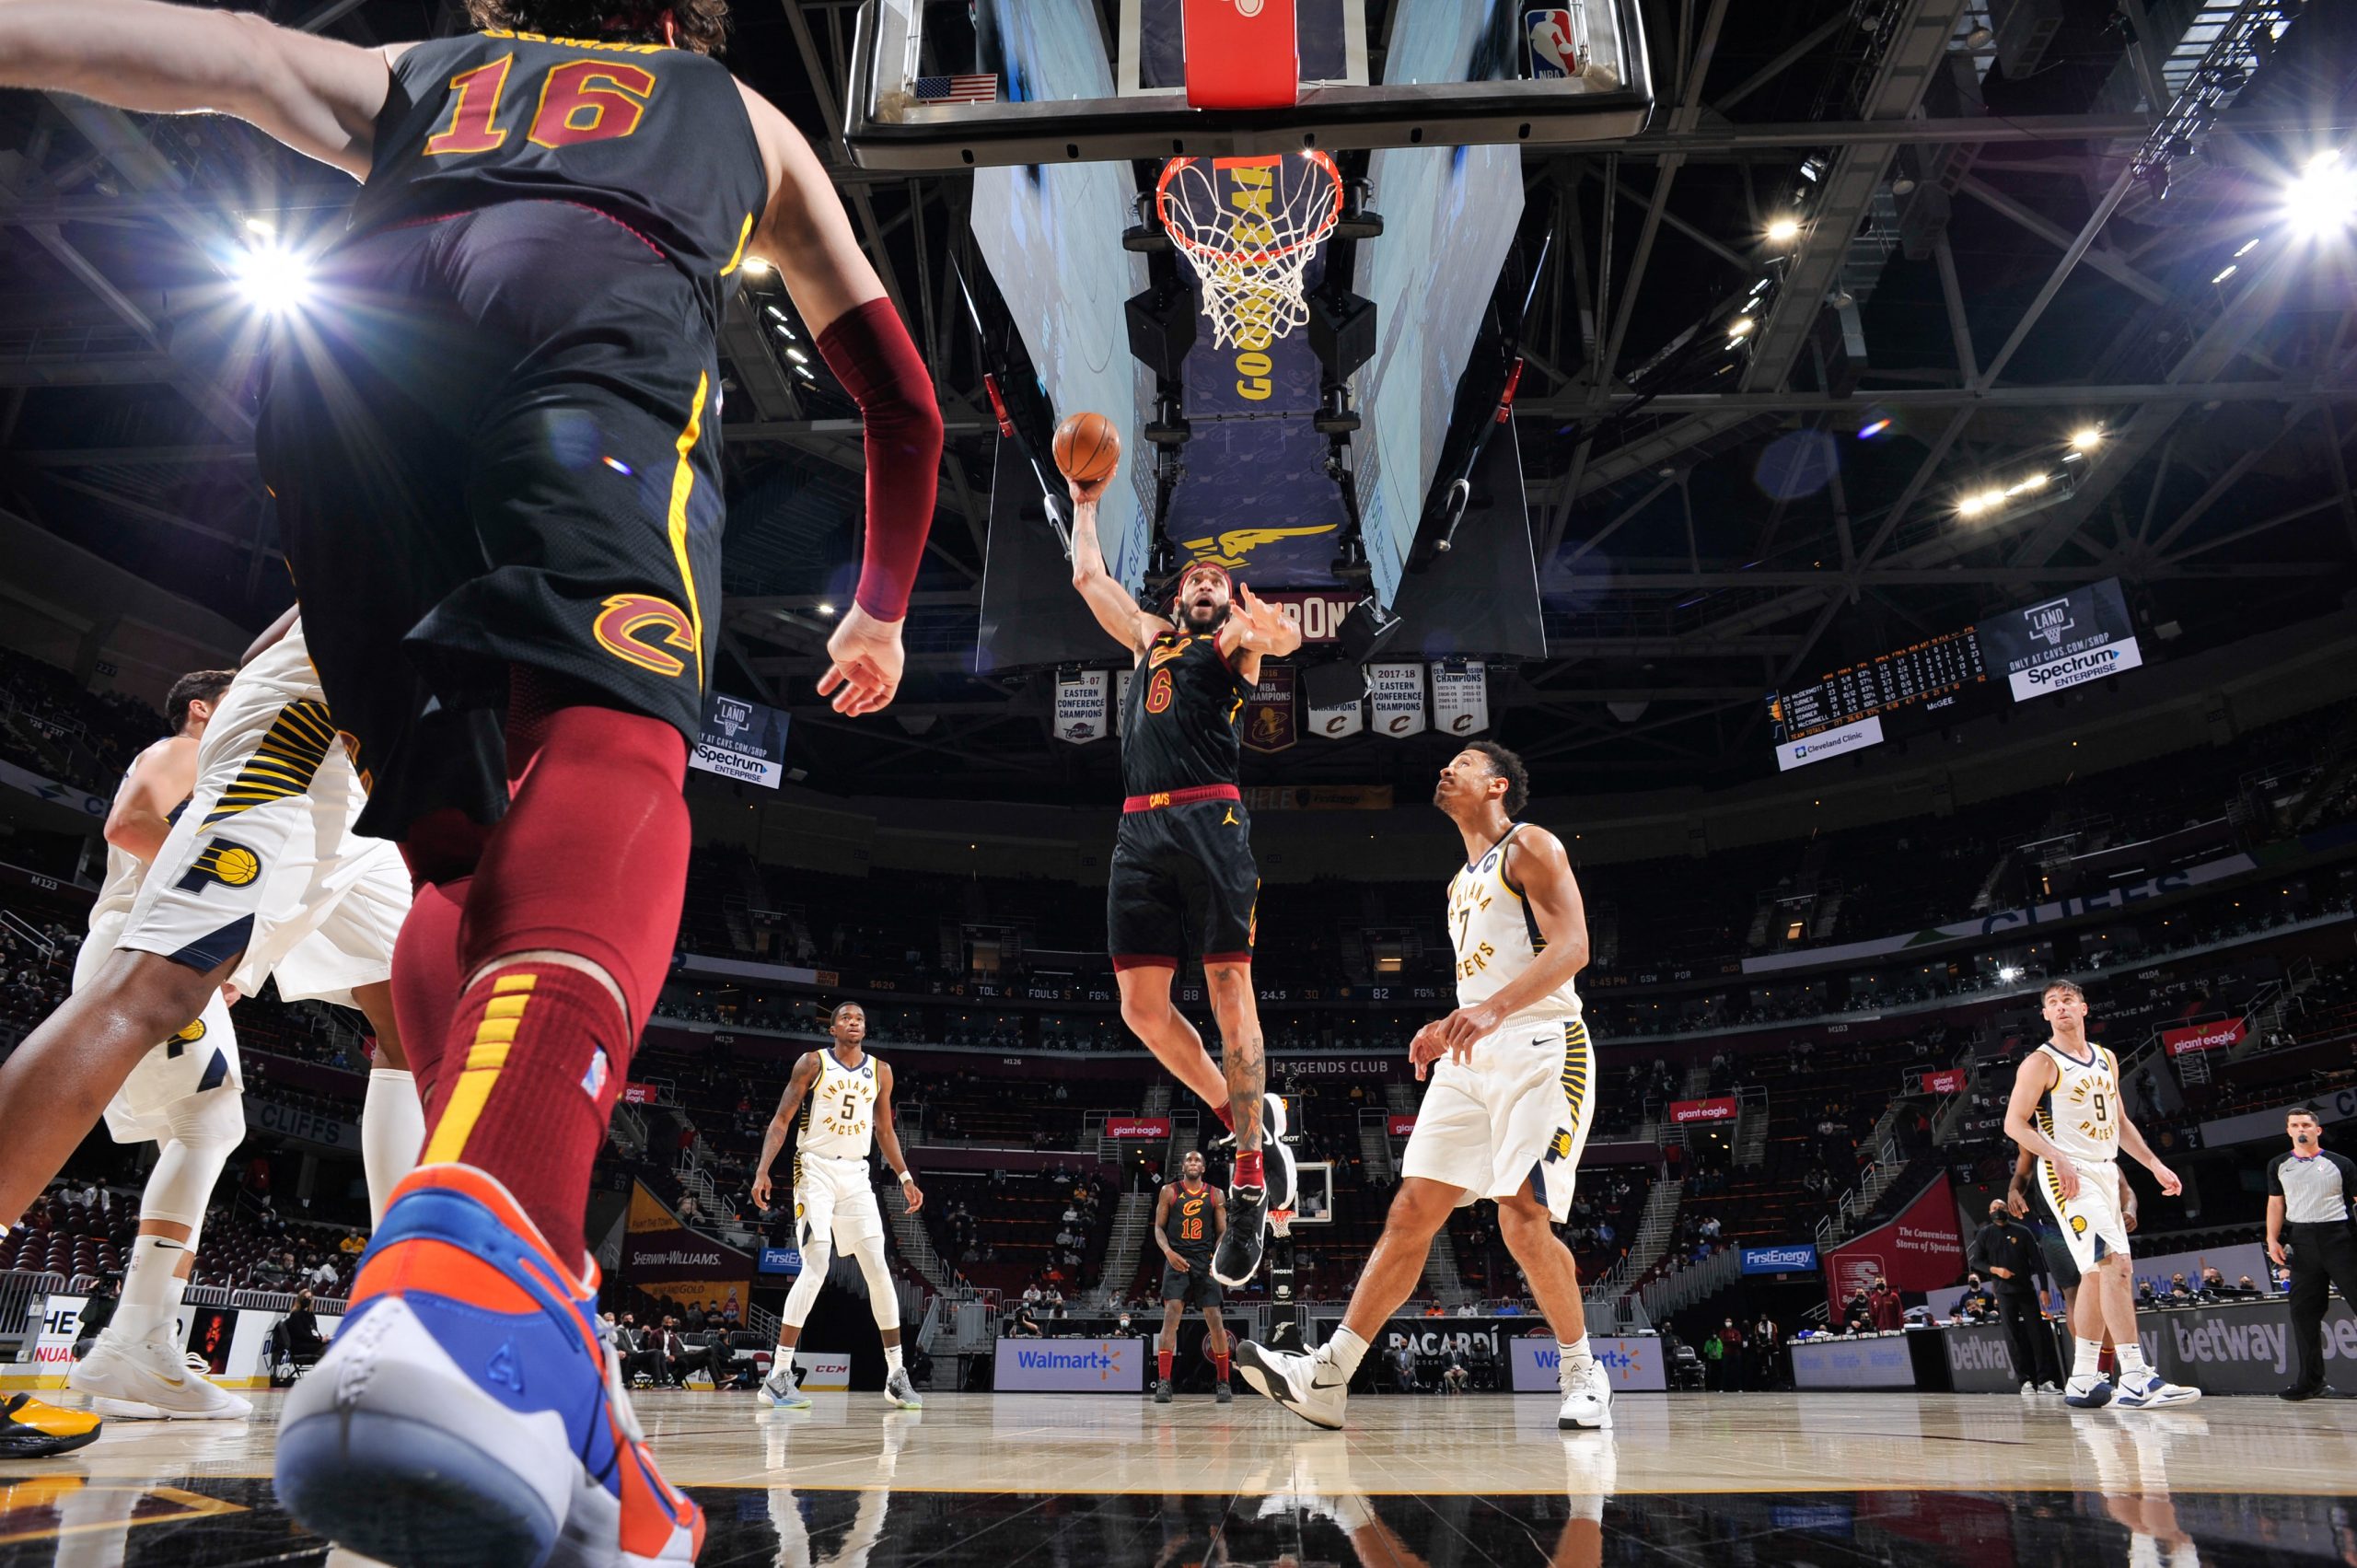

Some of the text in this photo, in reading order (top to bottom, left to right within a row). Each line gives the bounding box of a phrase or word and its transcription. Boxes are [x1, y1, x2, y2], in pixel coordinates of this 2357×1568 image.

[423, 52, 656, 156] 16
[2033, 608, 2064, 630] LAND
[2009, 632, 2109, 671] ONLY AT CAVS.COM/SHOP
[1378, 669, 1416, 679] 2017-18
[2027, 649, 2112, 684] Spectrum
[1436, 675, 1481, 683] CHAMPIONS
[2055, 663, 2118, 688] ENTERPRISE
[1064, 689, 1098, 698] EASTERN
[1145, 668, 1172, 714] 6
[1259, 682, 1276, 692] NBA
[1379, 682, 1414, 691] EASTERN
[1791, 684, 1823, 700] McDERMOTT
[1058, 698, 1105, 708] CONFERENCE
[1250, 691, 1291, 702] HAMPIONS
[1374, 692, 1422, 701] CONFERENCE
[1793, 694, 1814, 706] TURNER
[721, 703, 746, 723] LAND
[1059, 709, 1103, 718] CHAMPIONS
[1376, 703, 1421, 711] CHAMPIONS
[1794, 701, 1818, 714] BROGDON
[1795, 709, 1817, 721] SUMNER
[1797, 714, 1829, 728] McCONNELL
[706, 733, 715, 744] AT
[716, 737, 768, 758] CAVS.COM/SHOP
[1807, 730, 1862, 753] Cleveland Clinic
[698, 745, 763, 774] Spectrum
[714, 764, 762, 783] ENTERPRISE
[1149, 792, 1170, 807] CAVS
[1448, 881, 1493, 921] NDIANA
[1459, 907, 1470, 952] 7
[1456, 941, 1495, 981] CERS
[1640, 970, 1691, 983] GSW POR
[1028, 988, 1059, 1000] FOULS
[1088, 990, 1109, 1001] FG%
[1183, 989, 1199, 1002] 88
[1260, 990, 1286, 1000] 24.5
[1373, 988, 1389, 999] 82
[1413, 988, 1435, 998] FG%
[2174, 1031, 2236, 1053] giant eagle
[1351, 1062, 1388, 1073] CLUB
[1933, 1076, 1953, 1086] giant
[2070, 1074, 2117, 1103] INDIANA
[626, 1087, 645, 1098] giant
[823, 1078, 873, 1103] INDIANA
[841, 1094, 856, 1121] 5
[1678, 1106, 1727, 1121] giant eagle
[2094, 1094, 2107, 1121] 9
[261, 1104, 340, 1144] CLIFFS
[823, 1116, 866, 1136] PACERS
[1113, 1125, 1162, 1136] giant eagle
[1396, 1123, 1415, 1134] gian
[2188, 1136, 2197, 1148] 2
[1962, 1171, 1971, 1183] 5
[1181, 1218, 1203, 1239] 12
[1898, 1226, 1958, 1241] The Convenience
[1896, 1238, 1919, 1249] Stores
[1920, 1241, 1928, 1253] of
[765, 1250, 803, 1264] FirstEn
[1747, 1249, 1811, 1264] FirstEnergy
[679, 1284, 705, 1295] GOLD
[2172, 1318, 2286, 1375] betway
[1948, 1334, 2016, 1379] betway
[815, 1365, 848, 1374] CCM
